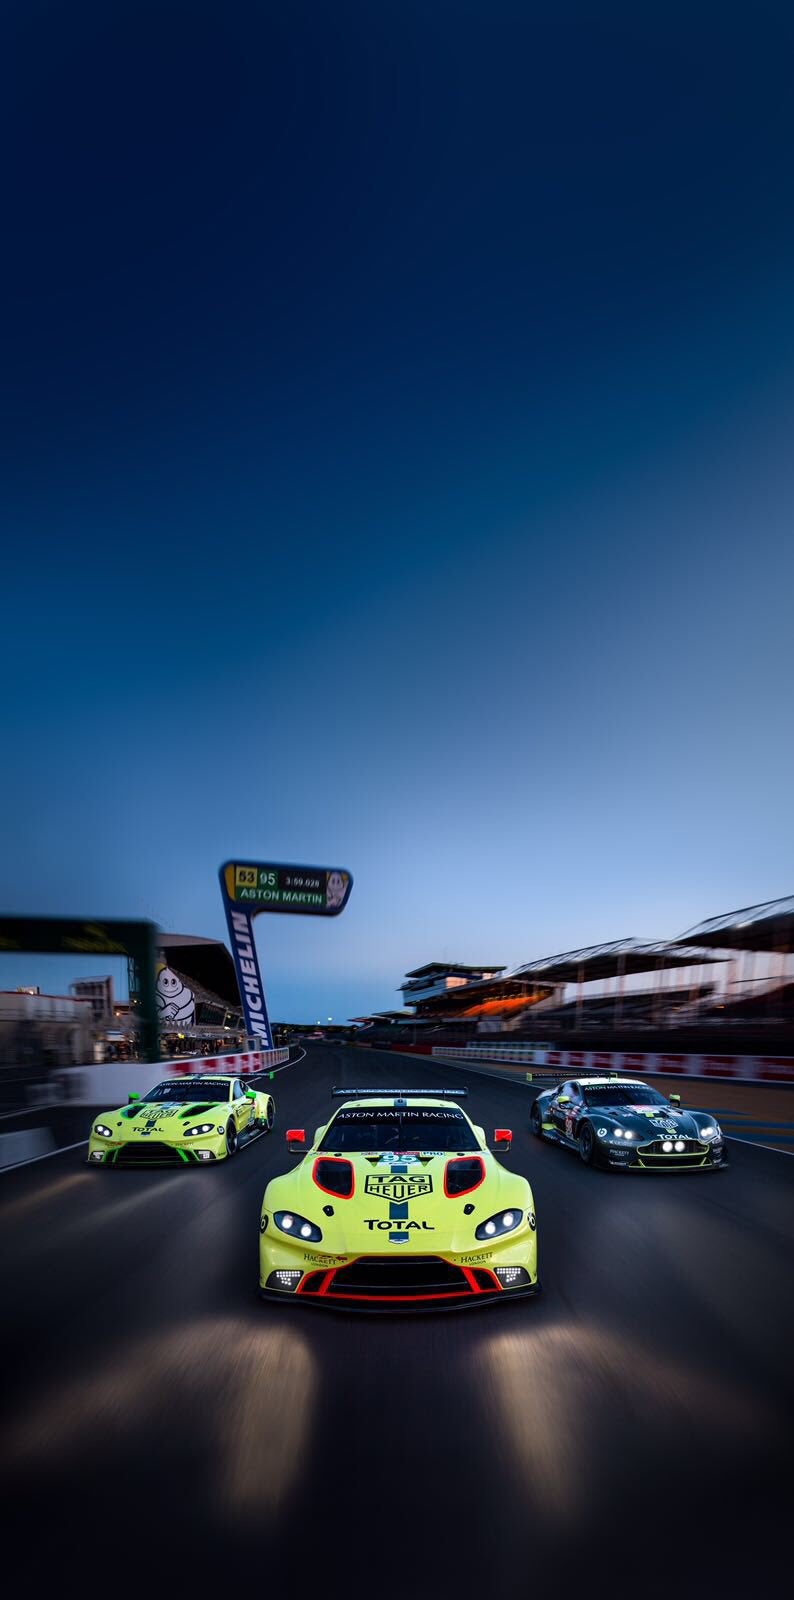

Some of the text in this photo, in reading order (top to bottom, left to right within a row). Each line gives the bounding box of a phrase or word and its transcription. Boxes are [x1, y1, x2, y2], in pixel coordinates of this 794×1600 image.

[238, 870, 255, 883] 53
[259, 873, 276, 885] 95
[240, 888, 322, 904] ASTON MARTIN
[231, 909, 269, 1047] MICHELIN
[422, 1112, 464, 1120] RACING
[382, 1154, 417, 1163] 95
[372, 1175, 426, 1183] TAG
[369, 1184, 428, 1199] HEUER
[363, 1219, 435, 1231] TOTAL
[304, 1253, 336, 1265] HACKETT
[460, 1252, 493, 1263] HACKETT
